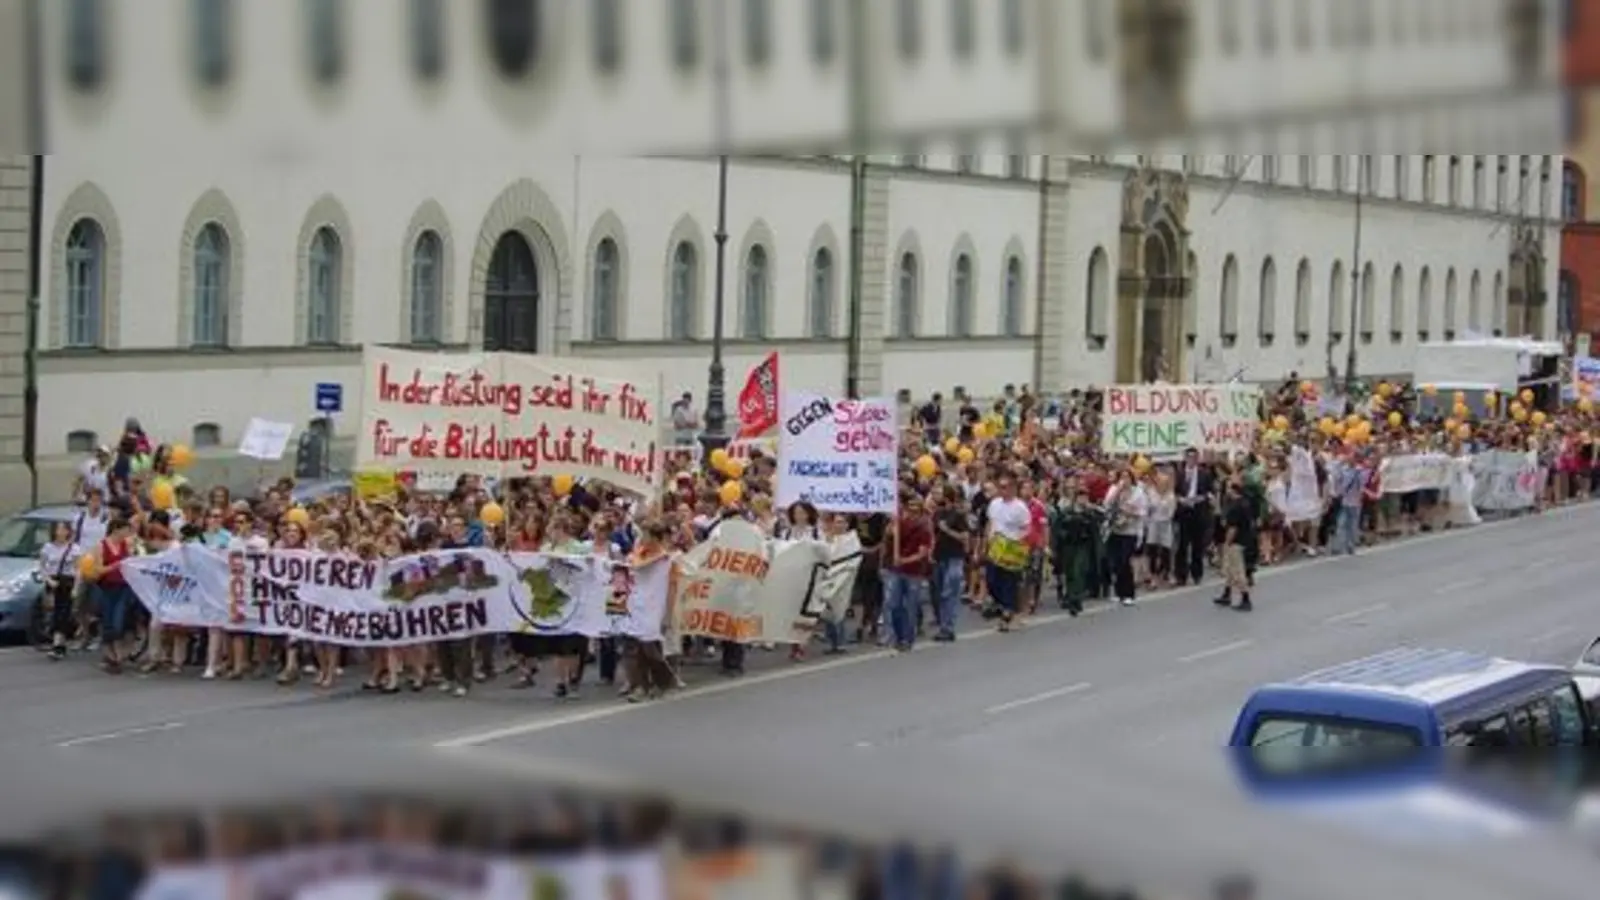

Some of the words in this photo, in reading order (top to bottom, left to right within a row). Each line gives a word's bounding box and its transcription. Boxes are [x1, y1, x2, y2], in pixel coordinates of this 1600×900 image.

[379, 362, 399, 401] In
[403, 368, 439, 404] der
[440, 368, 521, 415] Rüstung
[528, 374, 573, 409] seid
[582, 378, 610, 414] ihr
[1108, 388, 1218, 415] BILDUNG
[1230, 390, 1258, 417] IST
[786, 398, 833, 435] GEGEN
[1112, 420, 1189, 447] KEINE
[374, 419, 408, 456] für
[409, 423, 439, 458] die
[444, 423, 538, 471] Bildung
[539, 422, 578, 463] tut
[581, 428, 608, 466] ihr
[614, 441, 655, 484] nix!
